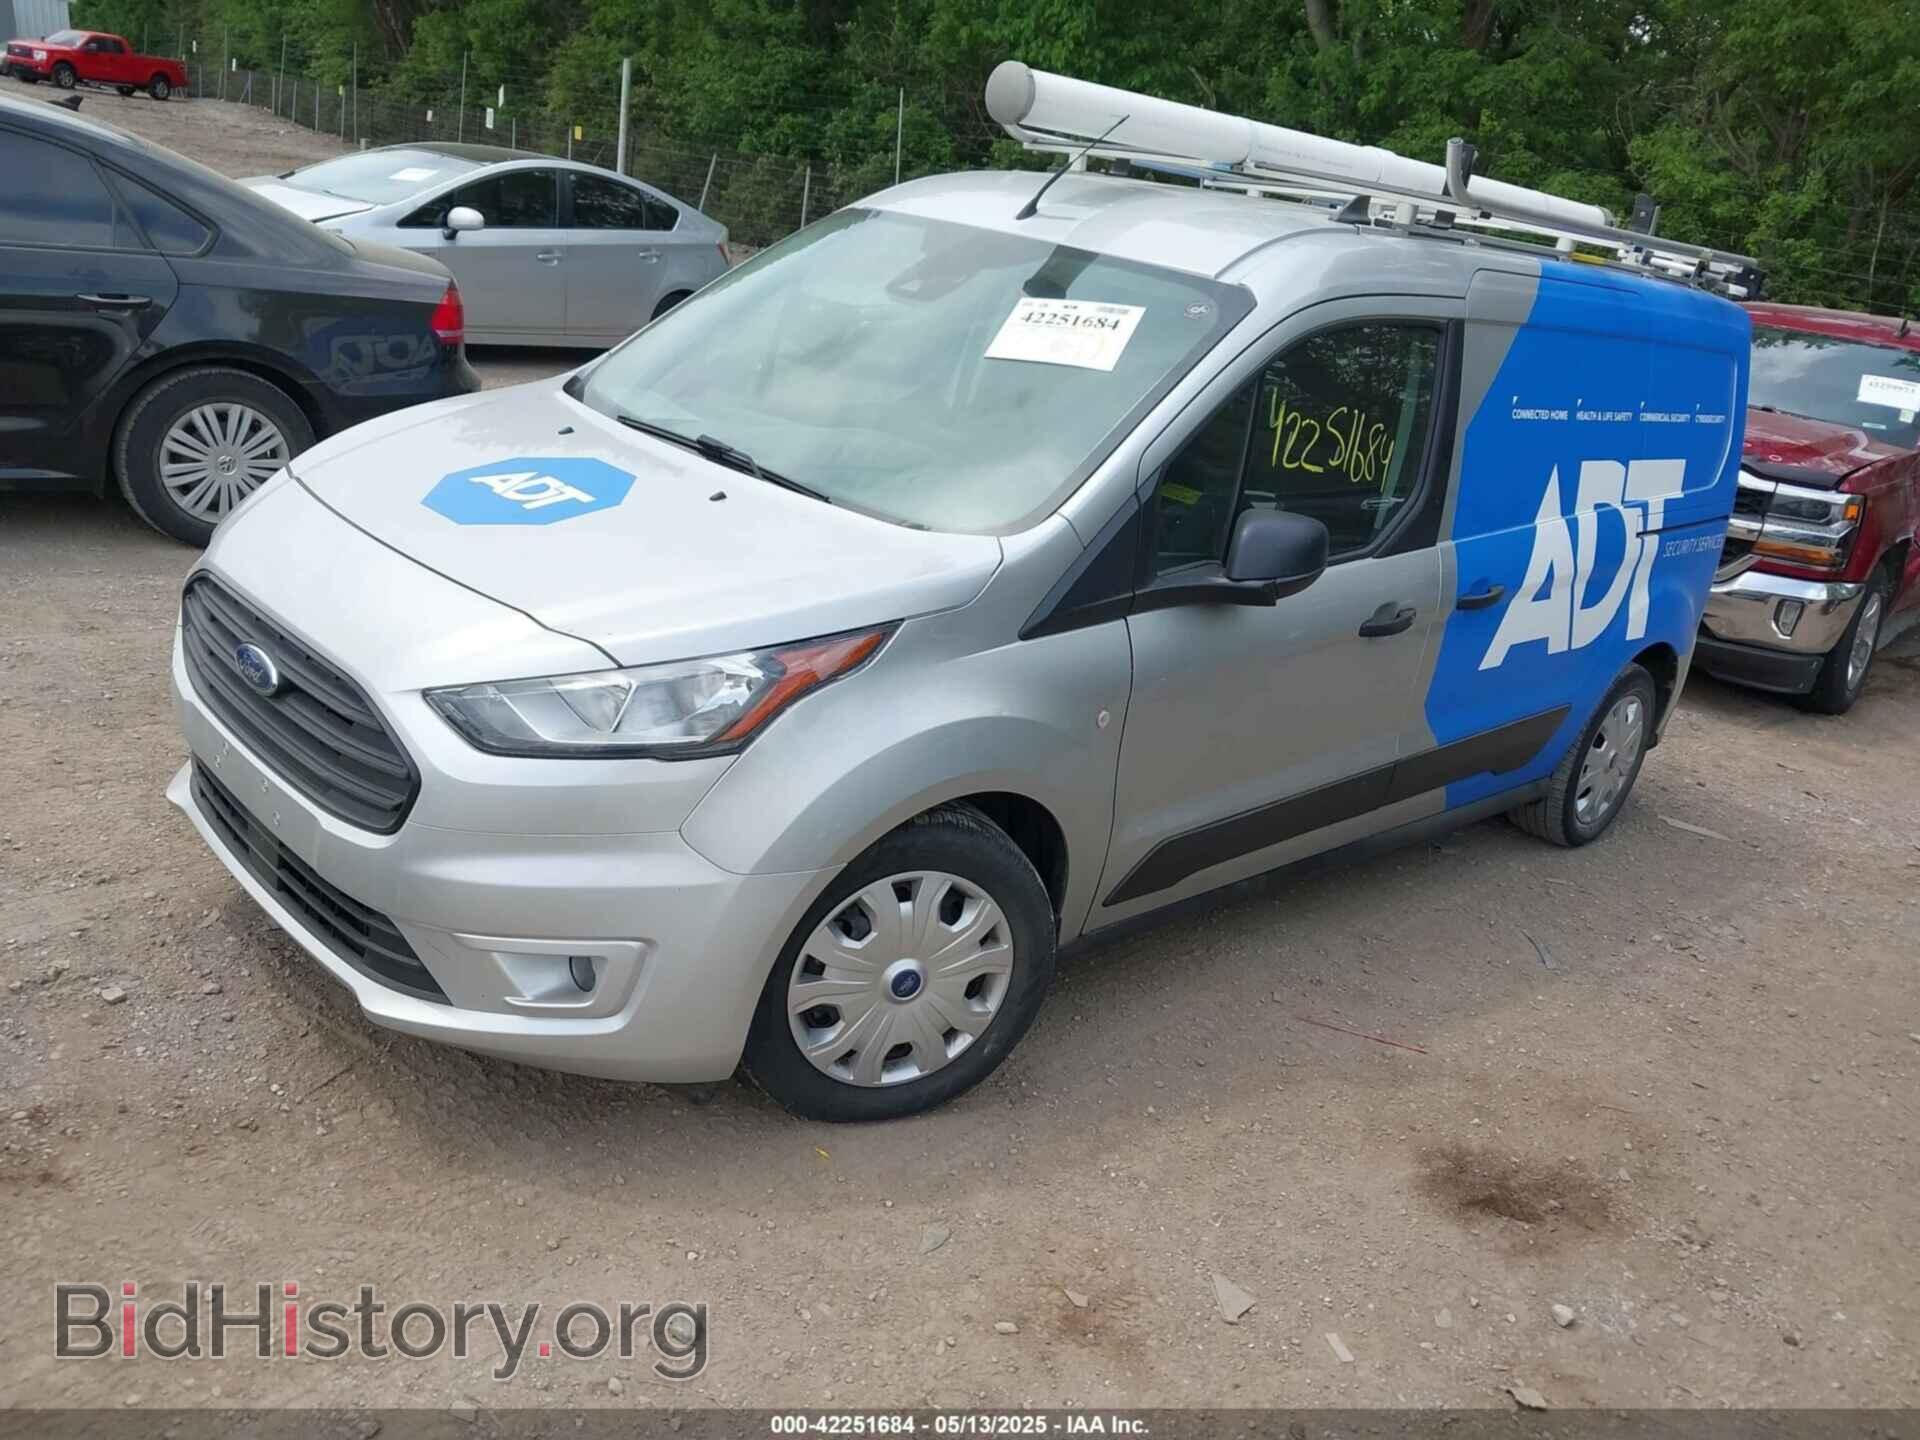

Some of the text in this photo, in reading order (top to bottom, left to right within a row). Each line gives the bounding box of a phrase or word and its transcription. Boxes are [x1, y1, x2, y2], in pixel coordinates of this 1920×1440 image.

[1021, 311, 1120, 330] 42251684
[1512, 408, 1568, 421] CONNECTED HOME
[468, 471, 597, 510] ADT
[1478, 459, 1687, 671] ADT
